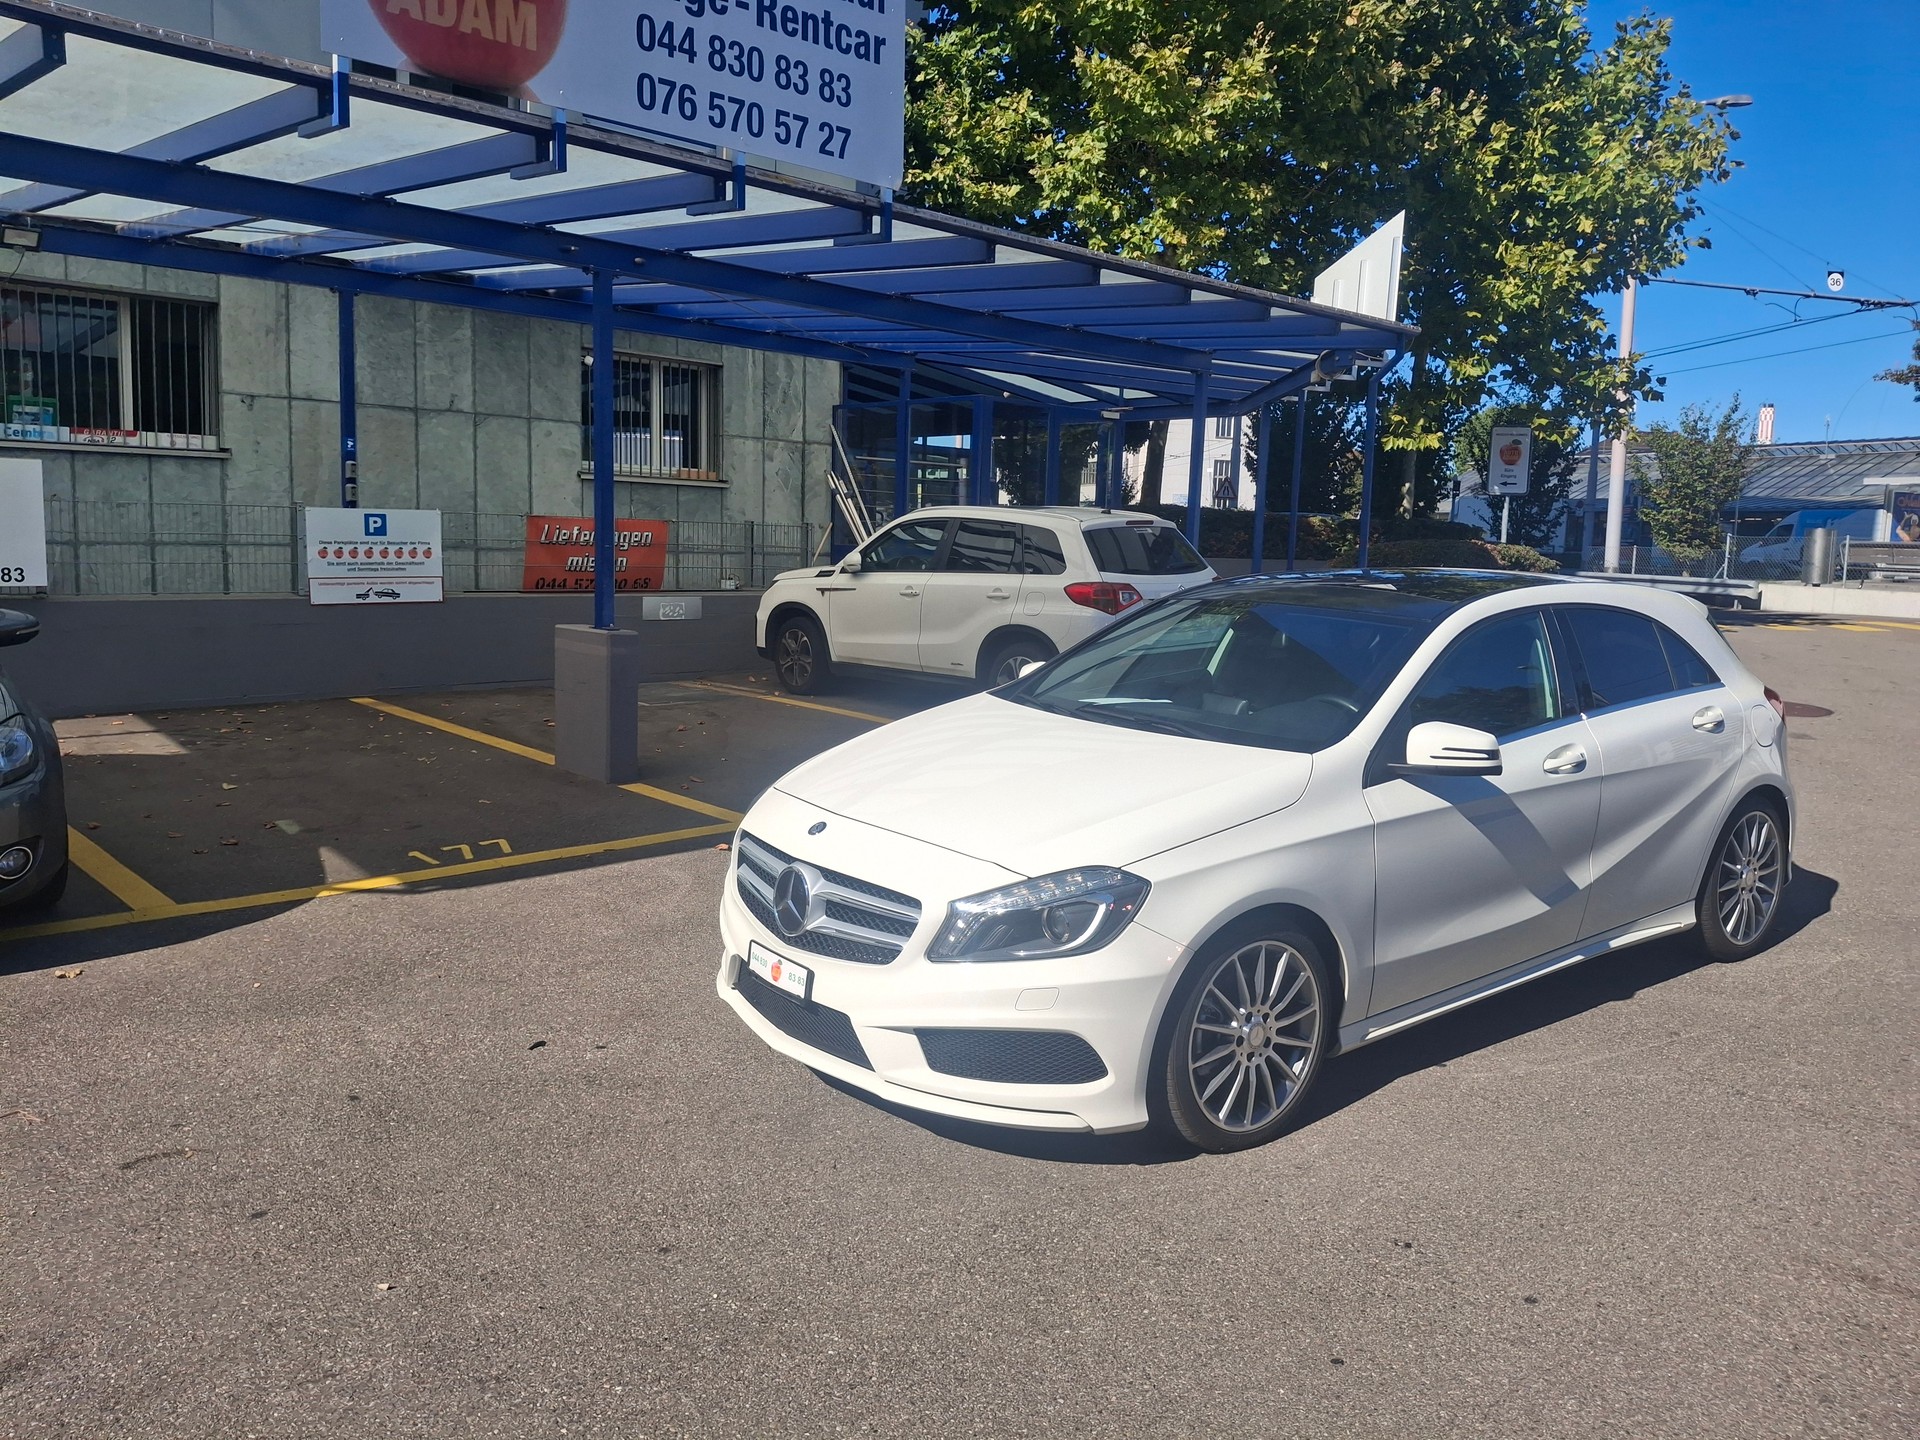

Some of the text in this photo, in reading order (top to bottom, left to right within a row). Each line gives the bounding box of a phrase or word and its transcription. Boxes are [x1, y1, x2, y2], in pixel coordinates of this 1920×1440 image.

[636, 13, 852, 108] 044 830 83 83
[636, 72, 852, 160] 076 570 57 27
[1829, 278, 1842, 287] 36
[368, 516, 382, 533] P
[541, 524, 652, 550] Liefergen
[565, 552, 628, 572] mien
[0, 567, 26, 583] 83
[408, 838, 512, 865] 177
[788, 972, 797, 982] 83
[797, 976, 805, 987] 83
